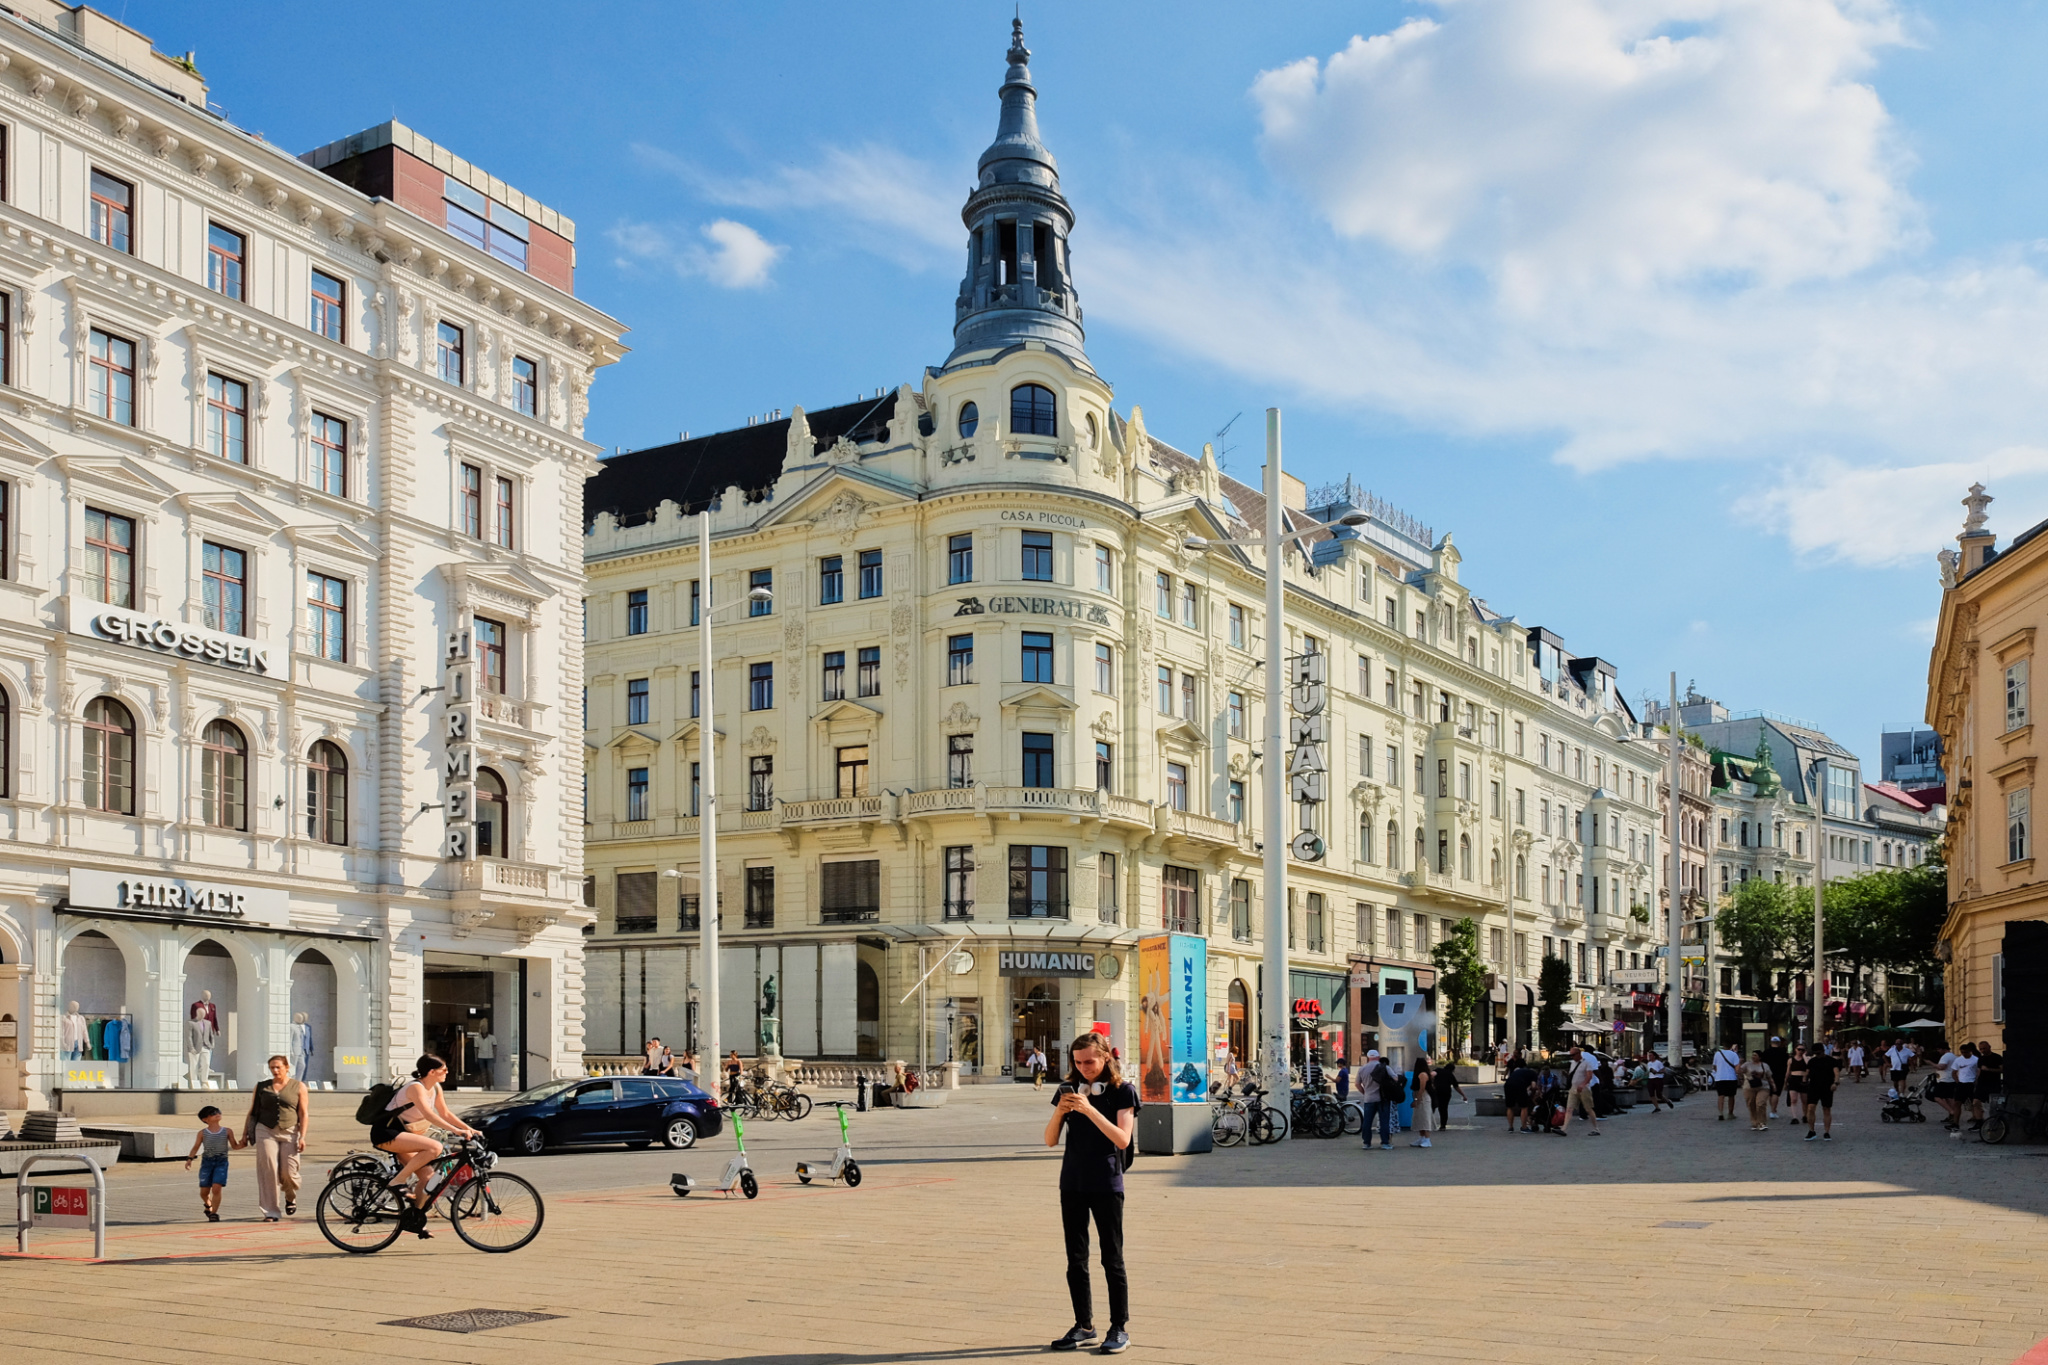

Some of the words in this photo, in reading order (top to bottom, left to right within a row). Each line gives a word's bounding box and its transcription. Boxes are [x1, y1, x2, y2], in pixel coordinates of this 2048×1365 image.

[1001, 510, 1034, 521] CASA
[1039, 512, 1086, 529] PICCOLA
[988, 596, 1082, 618] GENERALI
[96, 612, 269, 671] GRÖSSEN
[444, 629, 469, 858] HIRMER
[1290, 653, 1328, 862] HUMANIC
[124, 880, 248, 914] HIRMER
[1000, 952, 1094, 971] HUMANIC
[1183, 956, 1193, 1058] IMPULSTANZ
[1296, 997, 1325, 1015] ara
[342, 1055, 368, 1065] SALE
[68, 1070, 105, 1082] SALE
[37, 1191, 48, 1210] P
